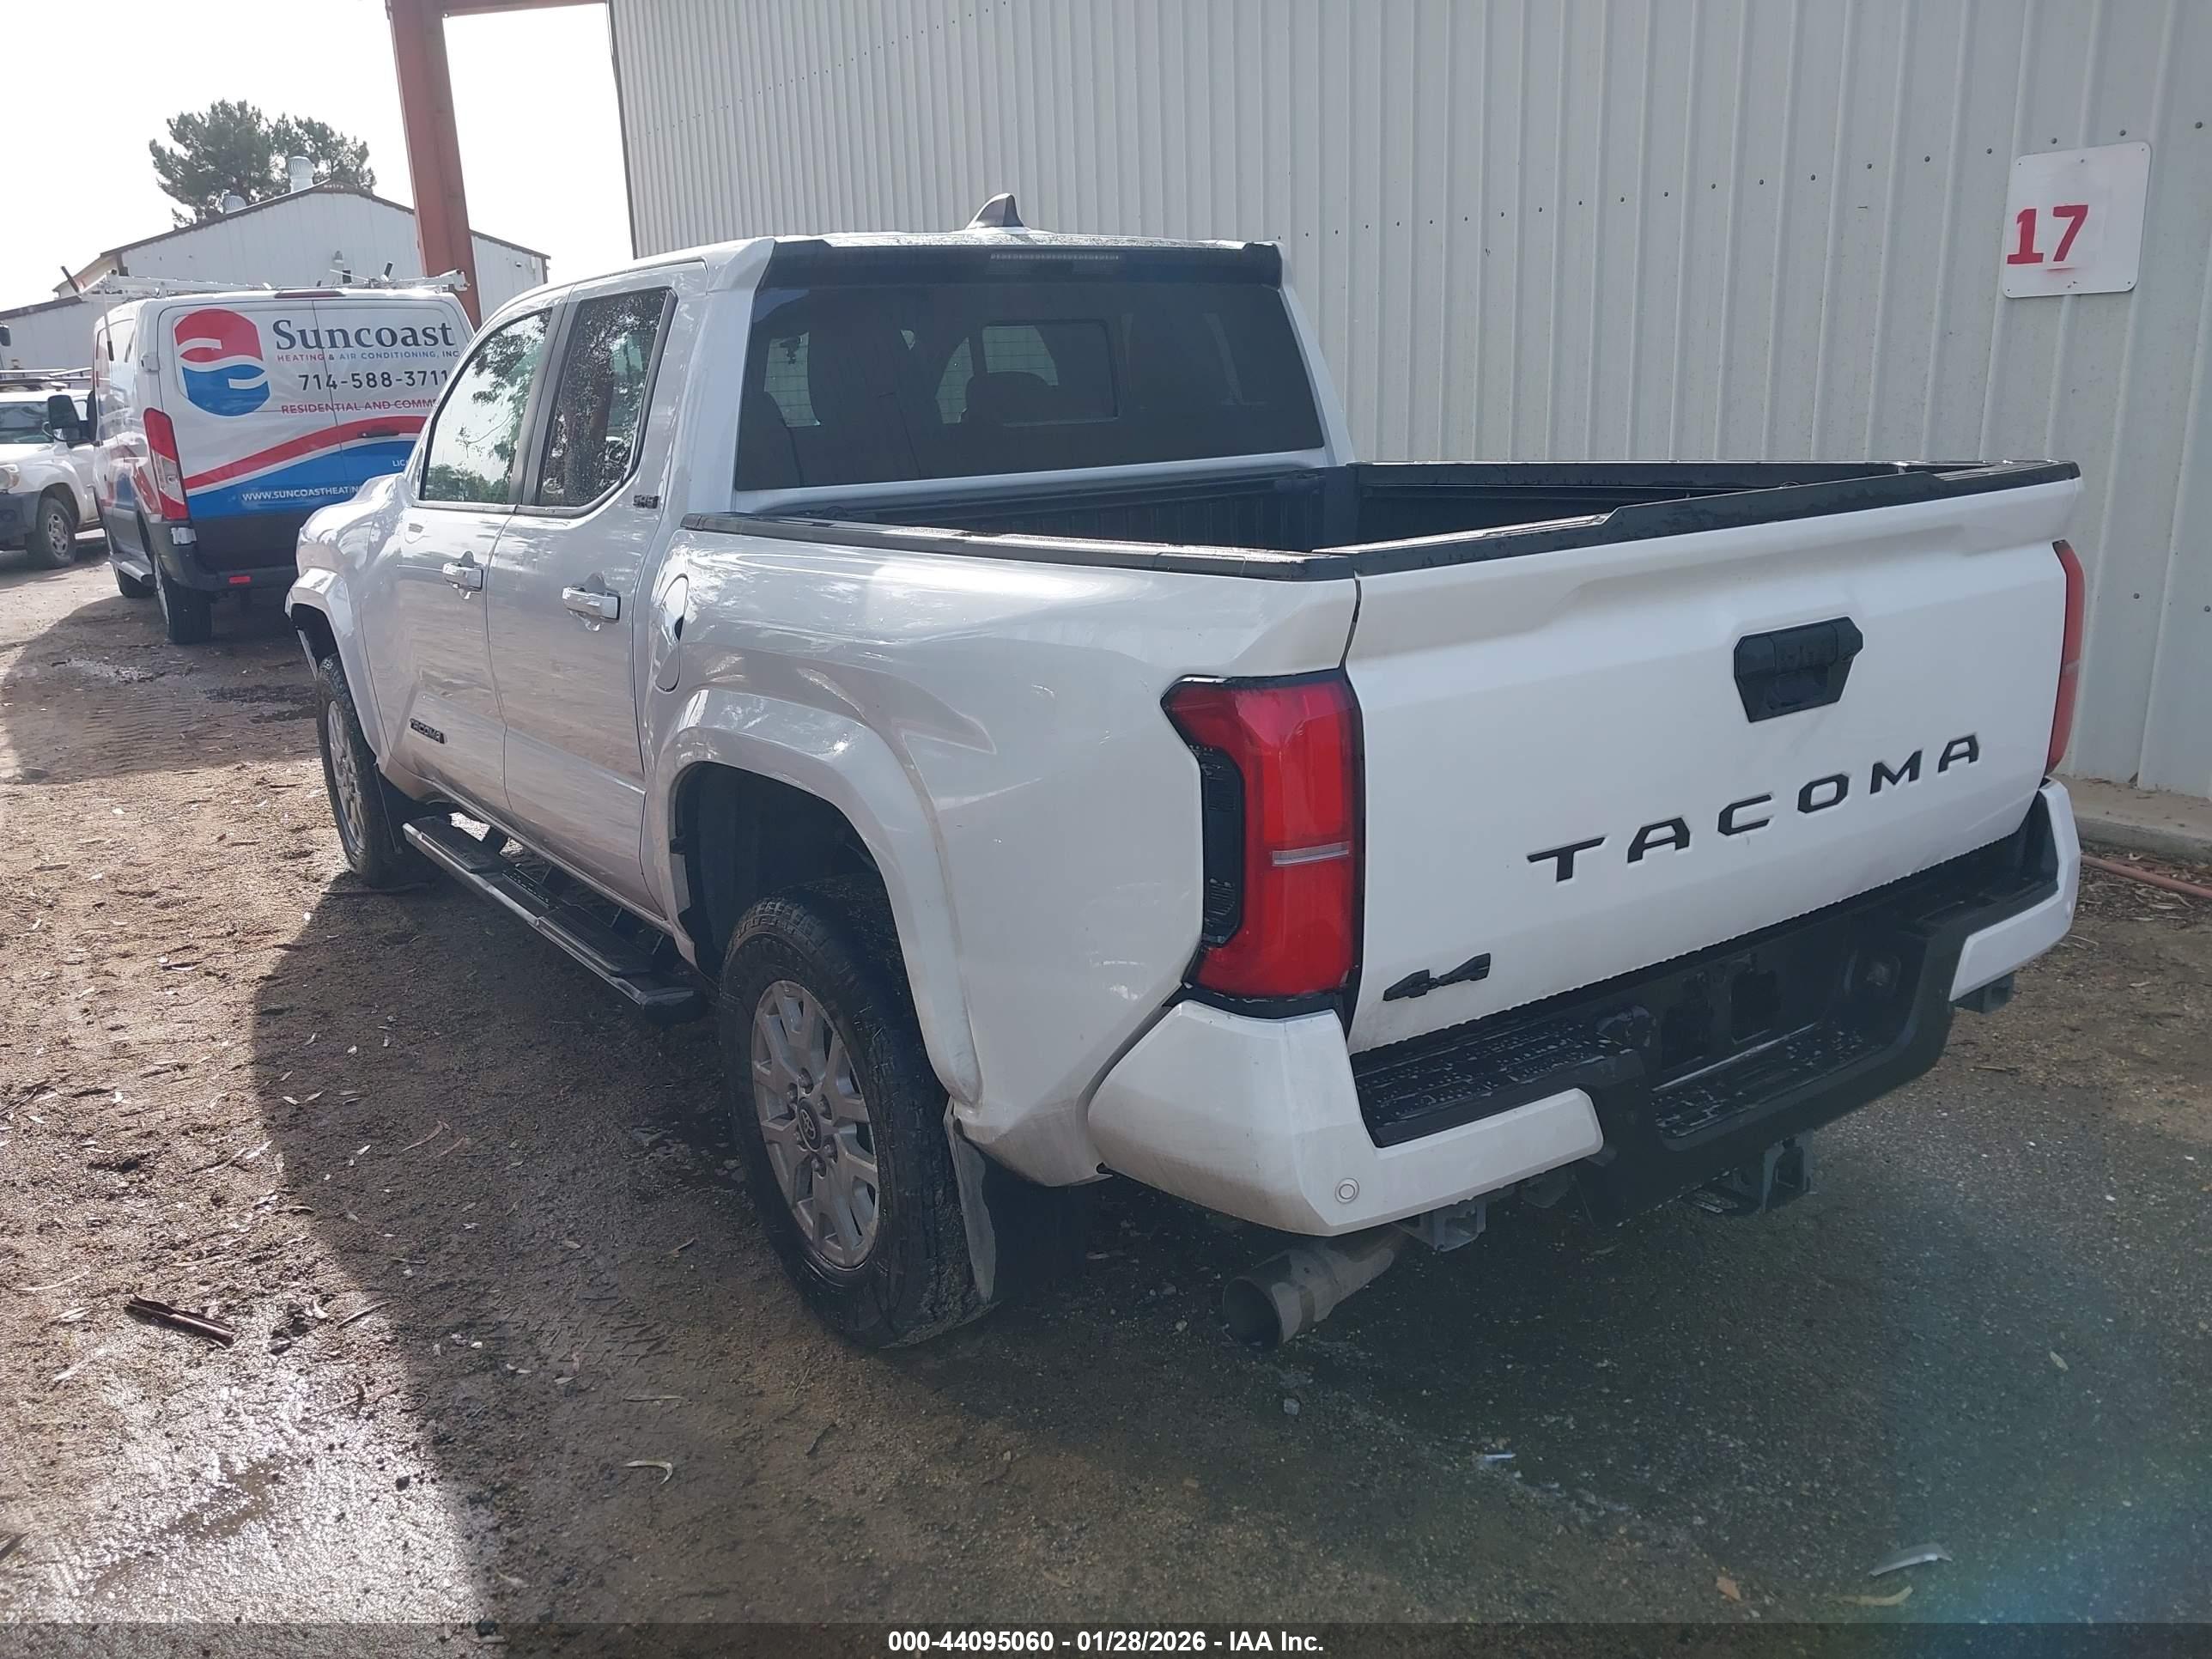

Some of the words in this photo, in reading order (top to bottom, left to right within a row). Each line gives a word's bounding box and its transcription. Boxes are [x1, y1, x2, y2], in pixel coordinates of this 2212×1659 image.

[2006, 204, 2089, 264] 17
[272, 319, 455, 350] Suncoast
[276, 353, 325, 362] HEATING
[361, 349, 441, 360] CONDITIONING,
[297, 369, 448, 391] 714-588-3711
[281, 402, 362, 415] RESIDENTIAL
[364, 400, 391, 410] AND
[1525, 732, 1981, 883] TACOMA
